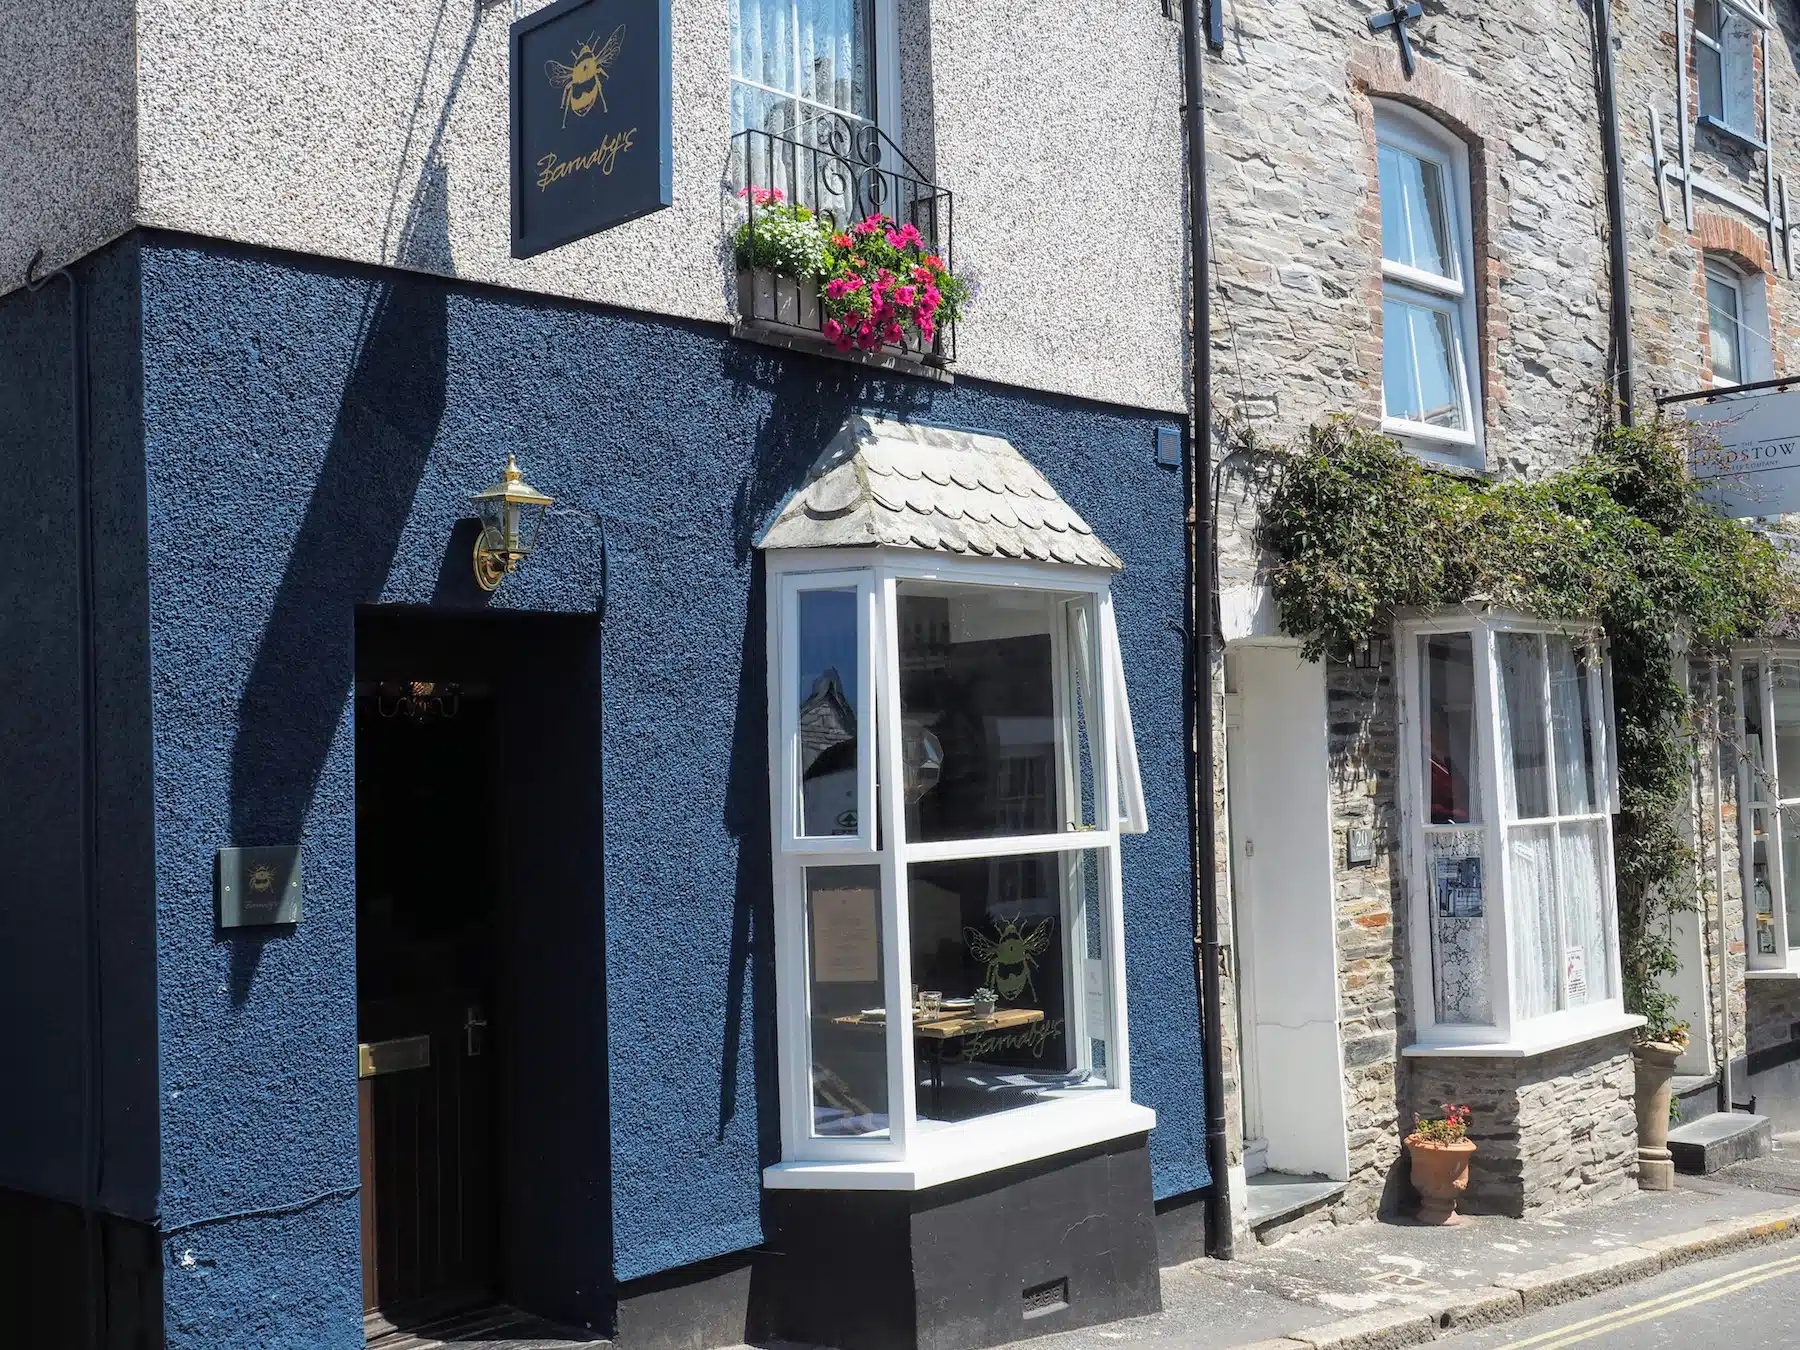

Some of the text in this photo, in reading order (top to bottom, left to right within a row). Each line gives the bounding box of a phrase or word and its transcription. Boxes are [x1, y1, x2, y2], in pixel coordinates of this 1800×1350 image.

[536, 127, 638, 192] Barnaby's
[1702, 442, 1796, 464] DSTOW
[1355, 830, 1368, 847] 20
